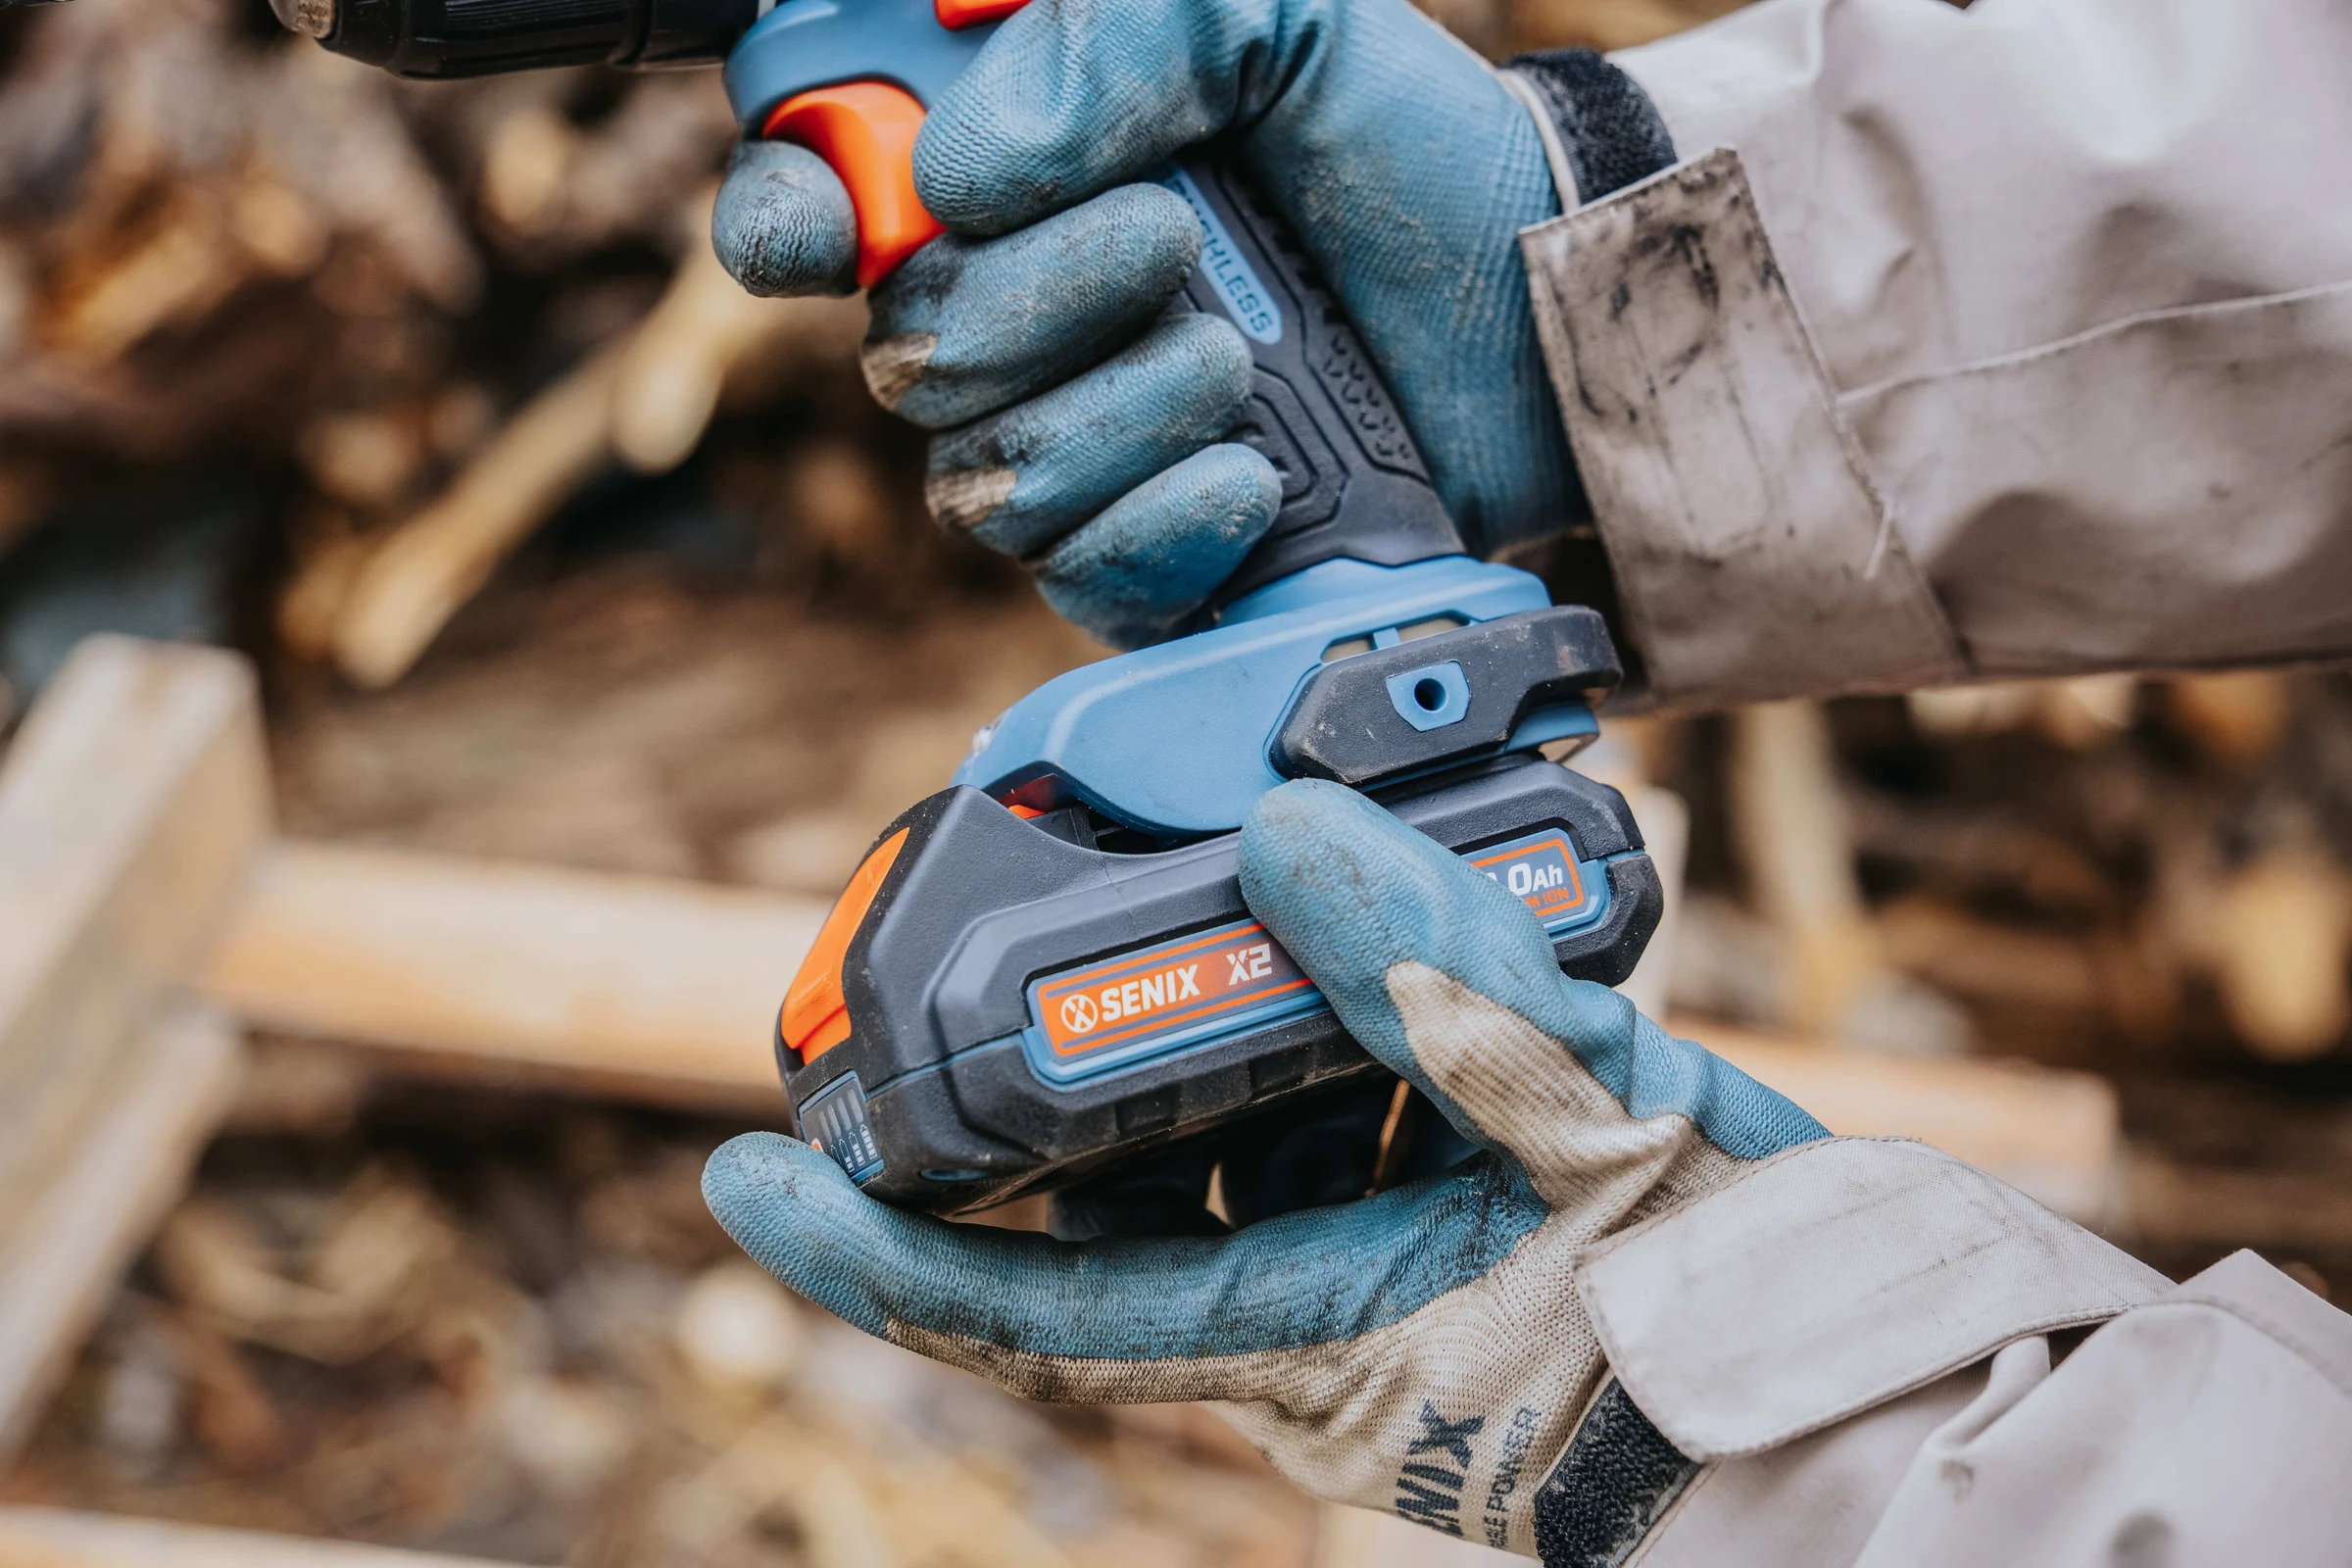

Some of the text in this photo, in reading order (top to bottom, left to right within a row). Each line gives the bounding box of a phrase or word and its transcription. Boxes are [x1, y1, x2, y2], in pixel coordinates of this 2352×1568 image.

[1176, 179, 1273, 333] HLESS
[1544, 886, 1570, 905] ION
[1100, 943, 1273, 1022] SENIX X2
